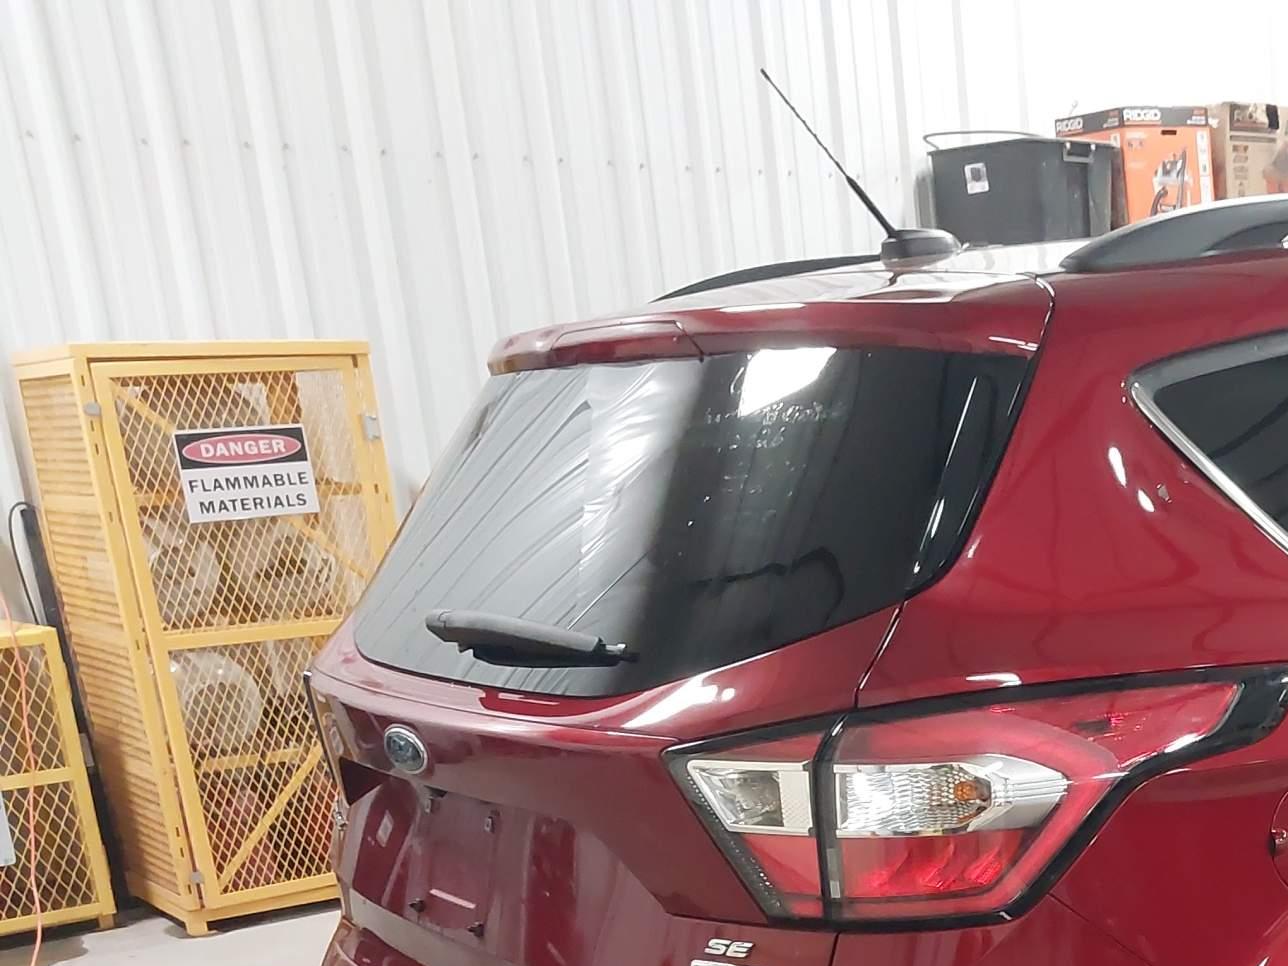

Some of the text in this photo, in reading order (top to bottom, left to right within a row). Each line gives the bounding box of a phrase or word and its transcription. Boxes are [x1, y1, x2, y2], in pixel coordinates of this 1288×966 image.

[200, 439, 286, 457] DANGER
[188, 471, 309, 493] FLAMMABLE
[199, 493, 307, 515] MATERIALS
[704, 938, 755, 958] SE
